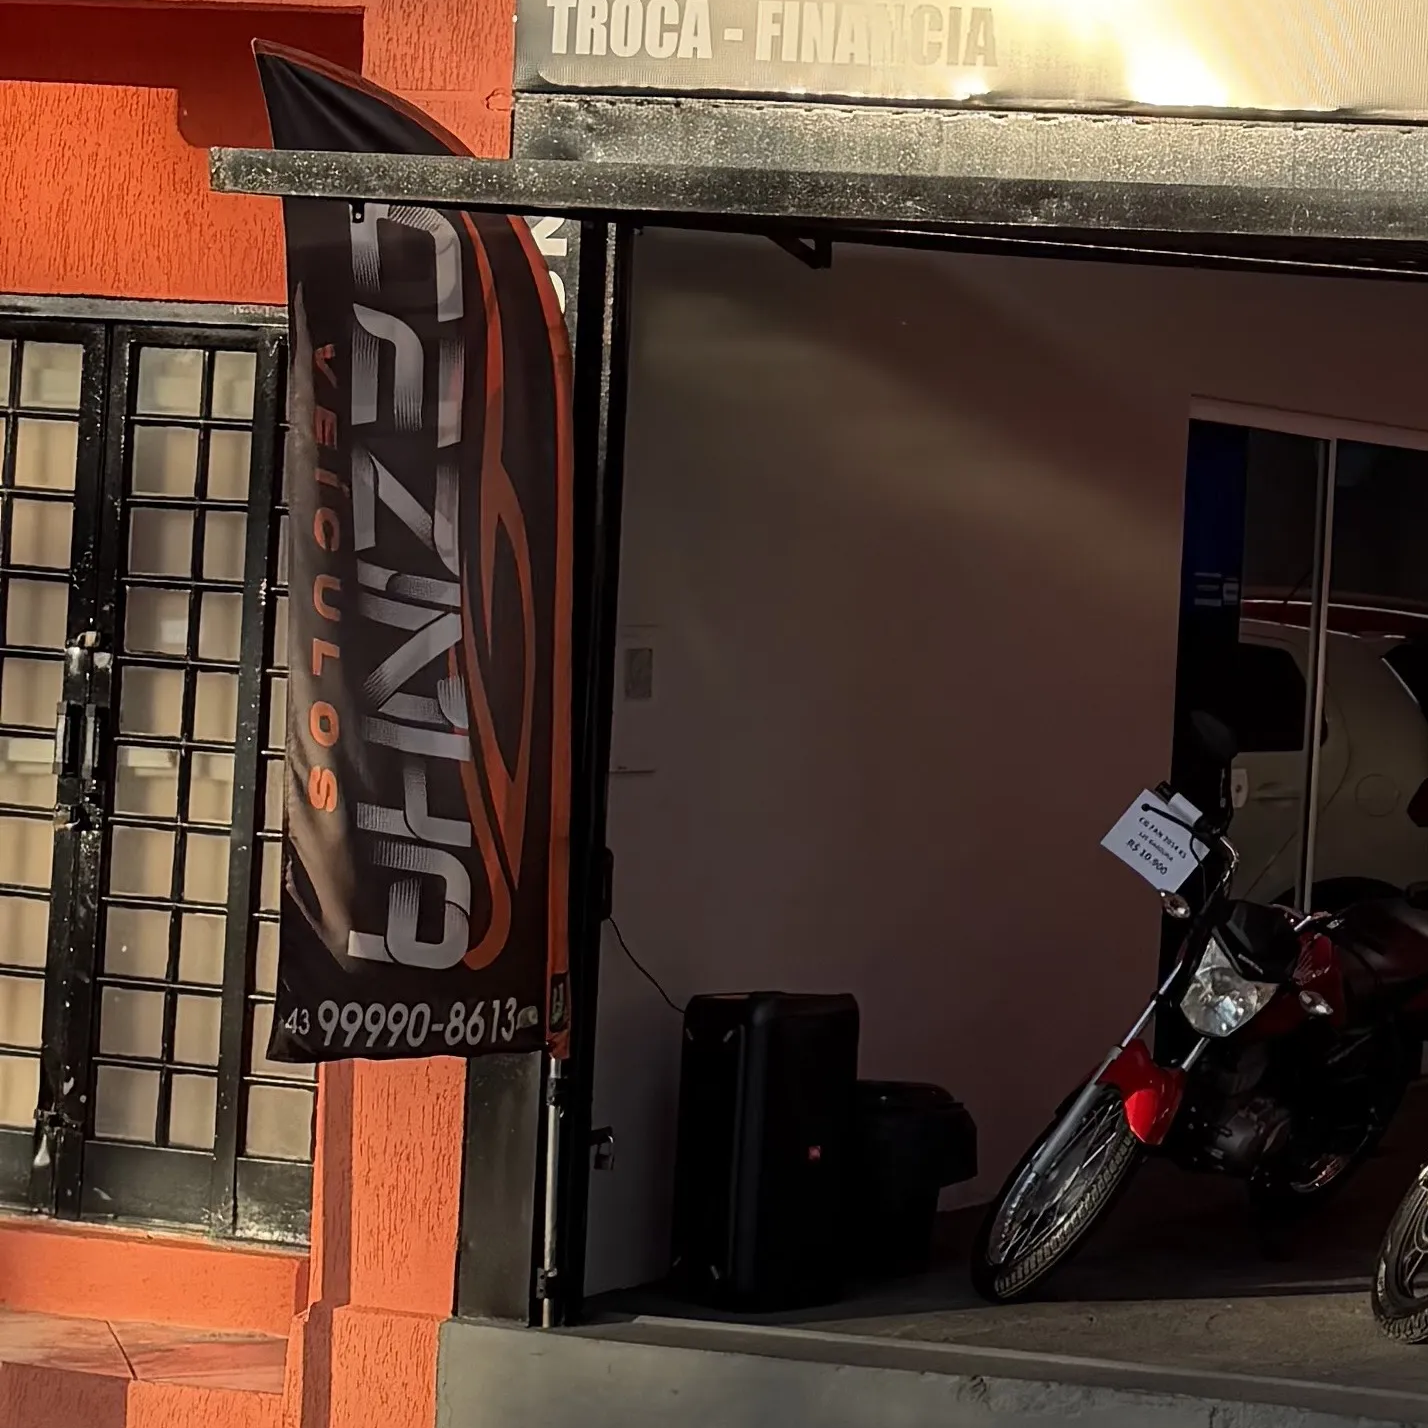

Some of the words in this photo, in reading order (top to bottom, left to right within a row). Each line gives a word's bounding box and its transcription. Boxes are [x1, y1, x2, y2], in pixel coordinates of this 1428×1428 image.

[755, 0, 999, 69] FINANCIA
[309, 343, 348, 815] VEÍCULOS
[347, 202, 473, 971] CEZINHA
[1128, 838, 1141, 851] R$
[285, 1007, 310, 1036] 43
[317, 996, 518, 1048] 99990-8613
